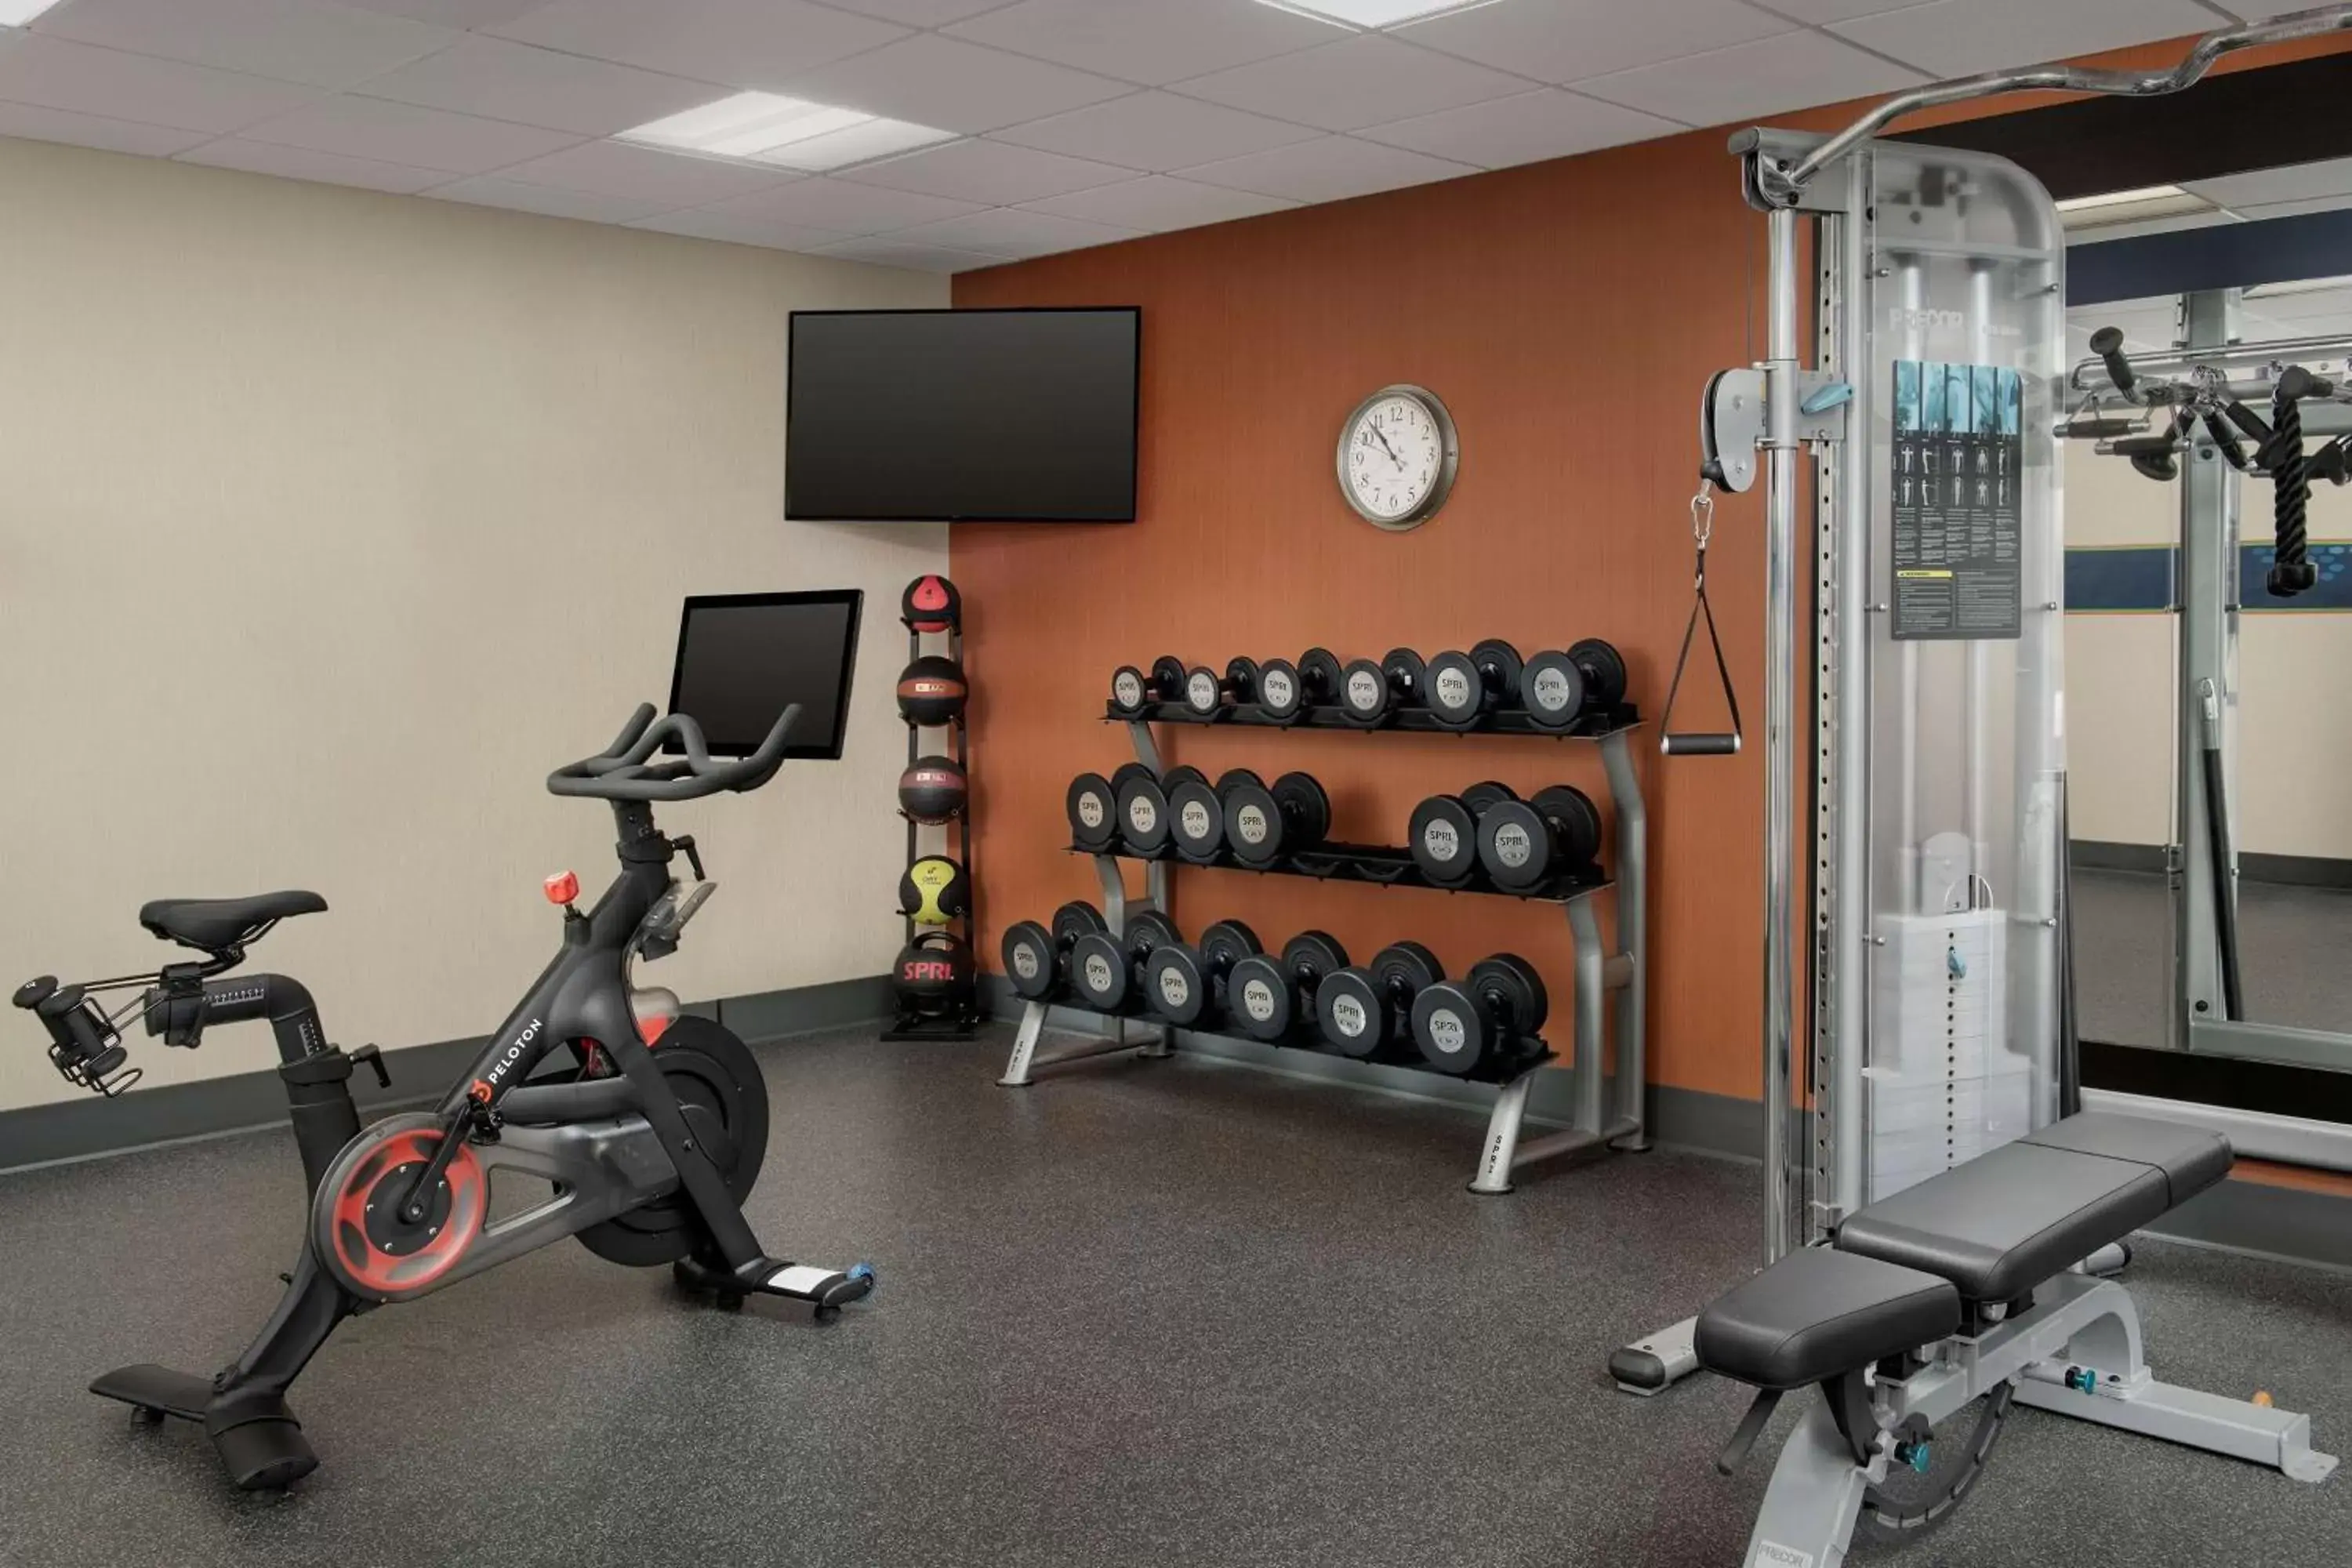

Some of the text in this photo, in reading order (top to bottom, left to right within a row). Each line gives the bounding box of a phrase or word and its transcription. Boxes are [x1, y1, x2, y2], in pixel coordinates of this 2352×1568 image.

[1374, 414, 1384, 428] 11
[1390, 406, 1403, 422] 12
[1410, 410, 1415, 426] 1
[1362, 430, 1374, 446] 10
[1421, 424, 1430, 440] 2
[1356, 451, 1365, 465] 9
[1425, 446, 1436, 463] 3
[1360, 473, 1370, 488] 8
[1419, 470, 1428, 485] 4
[1374, 487, 1381, 503] 7
[1388, 494, 1398, 510] 6
[1407, 486, 1416, 503] 5
[1442, 678, 1463, 689] SPRI
[1429, 830, 1451, 841] SPRI
[1499, 836, 1523, 846] SPRI
[903, 961, 953, 980] SPRI
[488, 1018, 543, 1084] PELOTON
